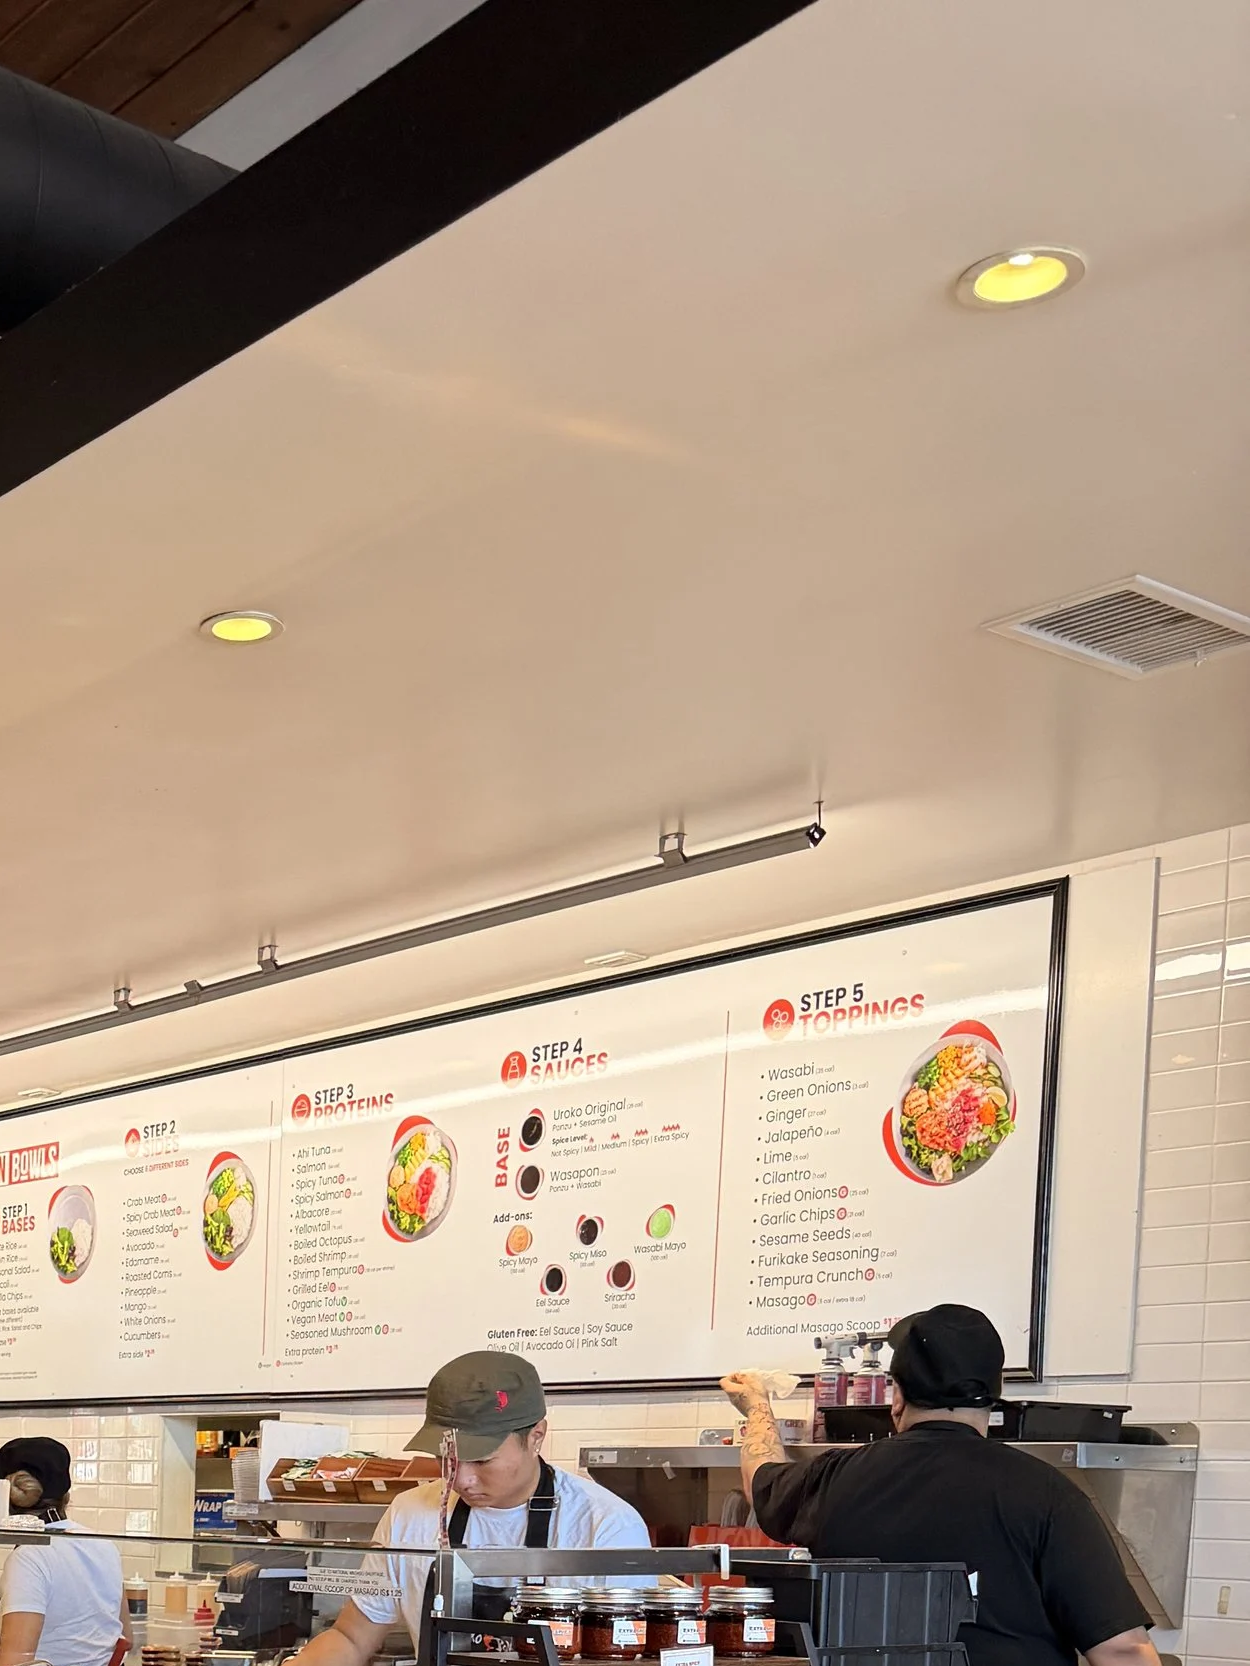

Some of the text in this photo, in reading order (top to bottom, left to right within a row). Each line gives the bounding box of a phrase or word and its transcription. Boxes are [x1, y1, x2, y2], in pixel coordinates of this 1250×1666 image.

[800, 983, 864, 1012] STEP 5
[799, 993, 924, 1036] TOPPINGS
[532, 1038, 583, 1062] STEP 4
[530, 1052, 608, 1084] SAUCES
[768, 1063, 815, 1081] Wasabi
[315, 1084, 353, 1105] STEP 3
[766, 1080, 851, 1103] Green Onions
[314, 1093, 394, 1126] PROTEINS
[554, 1098, 626, 1121] Uroko Original
[766, 1106, 807, 1125] Ginger
[144, 1120, 175, 1139] STEP 2
[765, 1126, 823, 1144] Jalapeño
[297, 1146, 330, 1159] Ahi Tuna
[551, 1131, 690, 1158] Not Spicy Mild Medium Spicy Extra Spicy
[12, 1145, 58, 1183] BOWLS
[495, 1126, 510, 1188] BASE
[763, 1150, 792, 1165] Lime
[297, 1162, 326, 1175] Salmon
[550, 1166, 600, 1185] Wasapon
[296, 1175, 338, 1190] Spicy Tuna
[762, 1169, 811, 1186] Cilantro
[127, 1195, 160, 1207] Crab Meat
[295, 1189, 344, 1206] Spicy Salmon
[761, 1186, 837, 1205] Fried Onions
[2, 1203, 28, 1219] STEP 1
[126, 1208, 175, 1223] Spicy Crab Meat
[295, 1207, 329, 1219] Albacore
[493, 1211, 532, 1223] Add-ons:
[760, 1208, 835, 1227] Garlic Chips
[2, 1216, 35, 1234] BASES
[126, 1223, 173, 1237] Seaweed Salad
[294, 1221, 331, 1235] Yellowtail
[294, 1235, 352, 1250] Boiled Octopus
[759, 1227, 851, 1247] Sesame Seeds
[126, 1241, 155, 1252] Avocado
[634, 1241, 686, 1254] Wasabi Mayo
[126, 1257, 159, 1267] Edamame
[293, 1250, 347, 1265] Boiled Shrimp
[569, 1250, 607, 1261] Spicy Miso
[758, 1246, 879, 1267] Furikake Seasoning
[293, 1265, 358, 1281] Shrimp Tempura
[758, 1268, 863, 1289] Tempura Crunch
[125, 1286, 156, 1298] Pineapple
[604, 1293, 635, 1303] Sriracha
[125, 1303, 147, 1313] Mango
[292, 1296, 341, 1312] Organic Tofu
[536, 1297, 570, 1308] Eel Sauce
[756, 1294, 805, 1310] Masago
[124, 1316, 166, 1326] White Onions
[291, 1313, 337, 1327] Vegan Meat
[746, 1323, 798, 1337] Additional
[801, 1321, 843, 1335] Masago
[846, 1319, 880, 1333] Scoop
[124, 1331, 161, 1341] Cucumbers
[291, 1325, 373, 1340] Seasoned Mushroom
[488, 1322, 633, 1339] Gluten Free: Eel Sauce Soy Sauce
[285, 1347, 300, 1357] Extra
[302, 1346, 325, 1358] protein
[292, 1582, 323, 1592] ADDITIONAL
[325, 1585, 344, 1593] SCOOP
[354, 1587, 378, 1596] MASAGO
